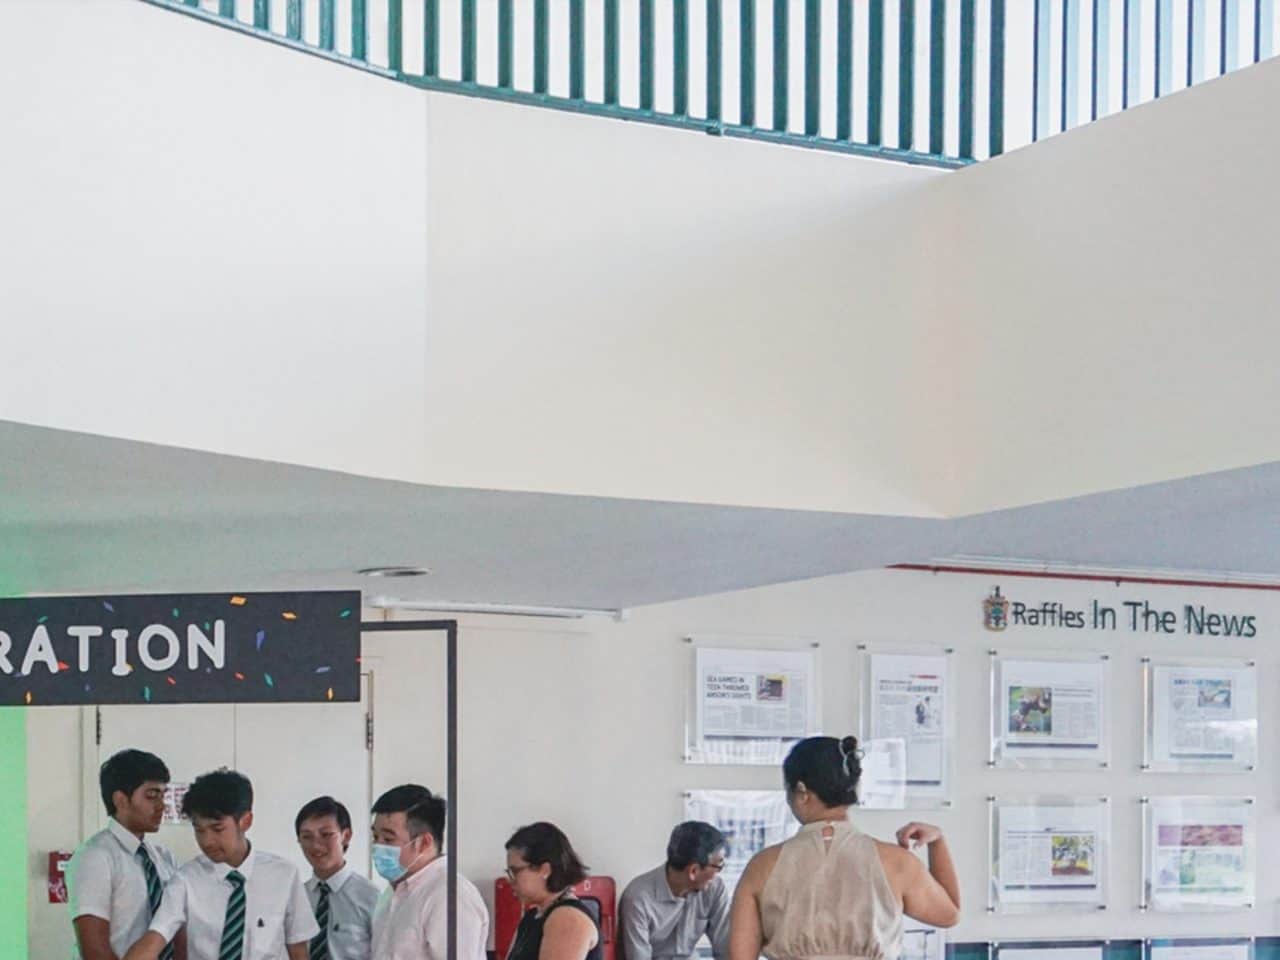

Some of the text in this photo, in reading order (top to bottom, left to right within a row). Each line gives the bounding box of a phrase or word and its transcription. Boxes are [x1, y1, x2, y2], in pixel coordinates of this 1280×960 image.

[1012, 599, 1257, 638] Raffles In The News
